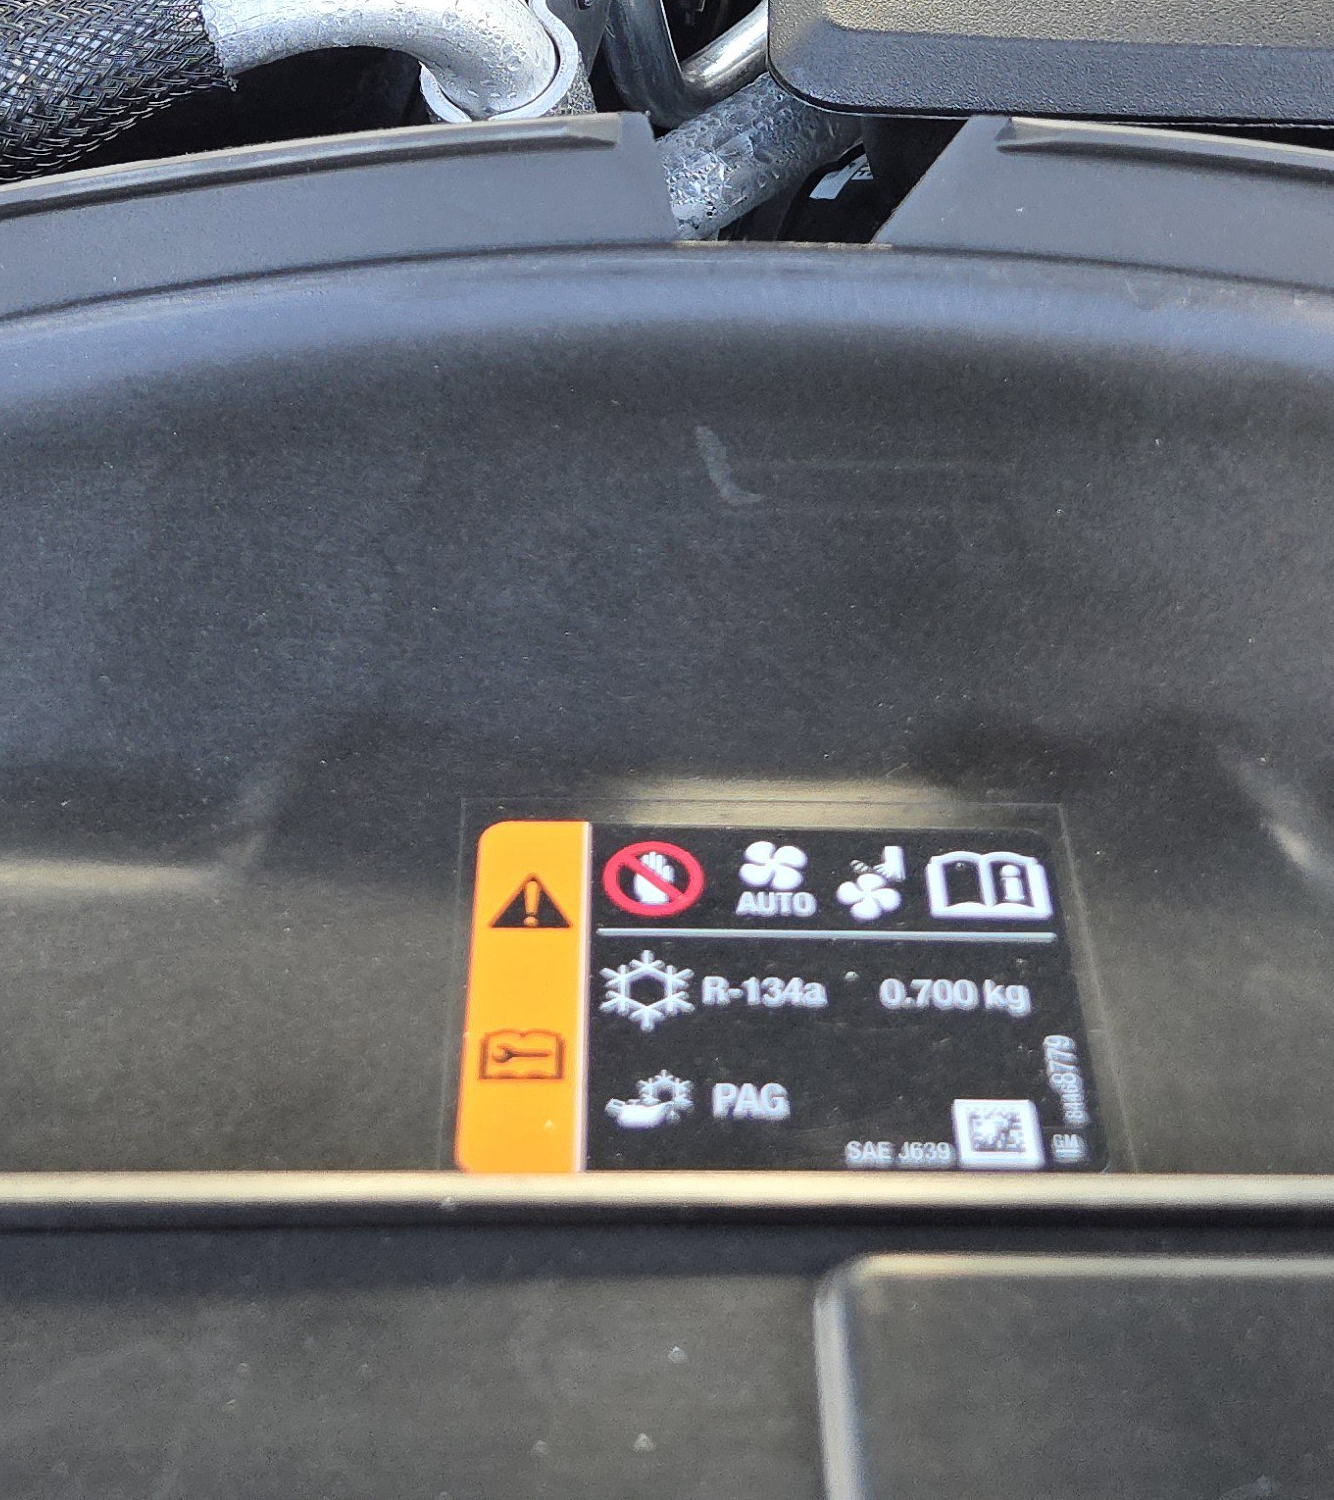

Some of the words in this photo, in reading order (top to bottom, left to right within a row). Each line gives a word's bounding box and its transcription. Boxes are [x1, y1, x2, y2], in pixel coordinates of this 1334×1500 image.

[736, 891, 816, 917] AUTO
[701, 975, 828, 1008] R-134a
[879, 978, 979, 1010] 0.700
[982, 978, 1032, 1017] kg
[712, 1082, 790, 1120] PAG
[845, 1140, 893, 1165] SAE
[896, 1140, 956, 1166] J639
